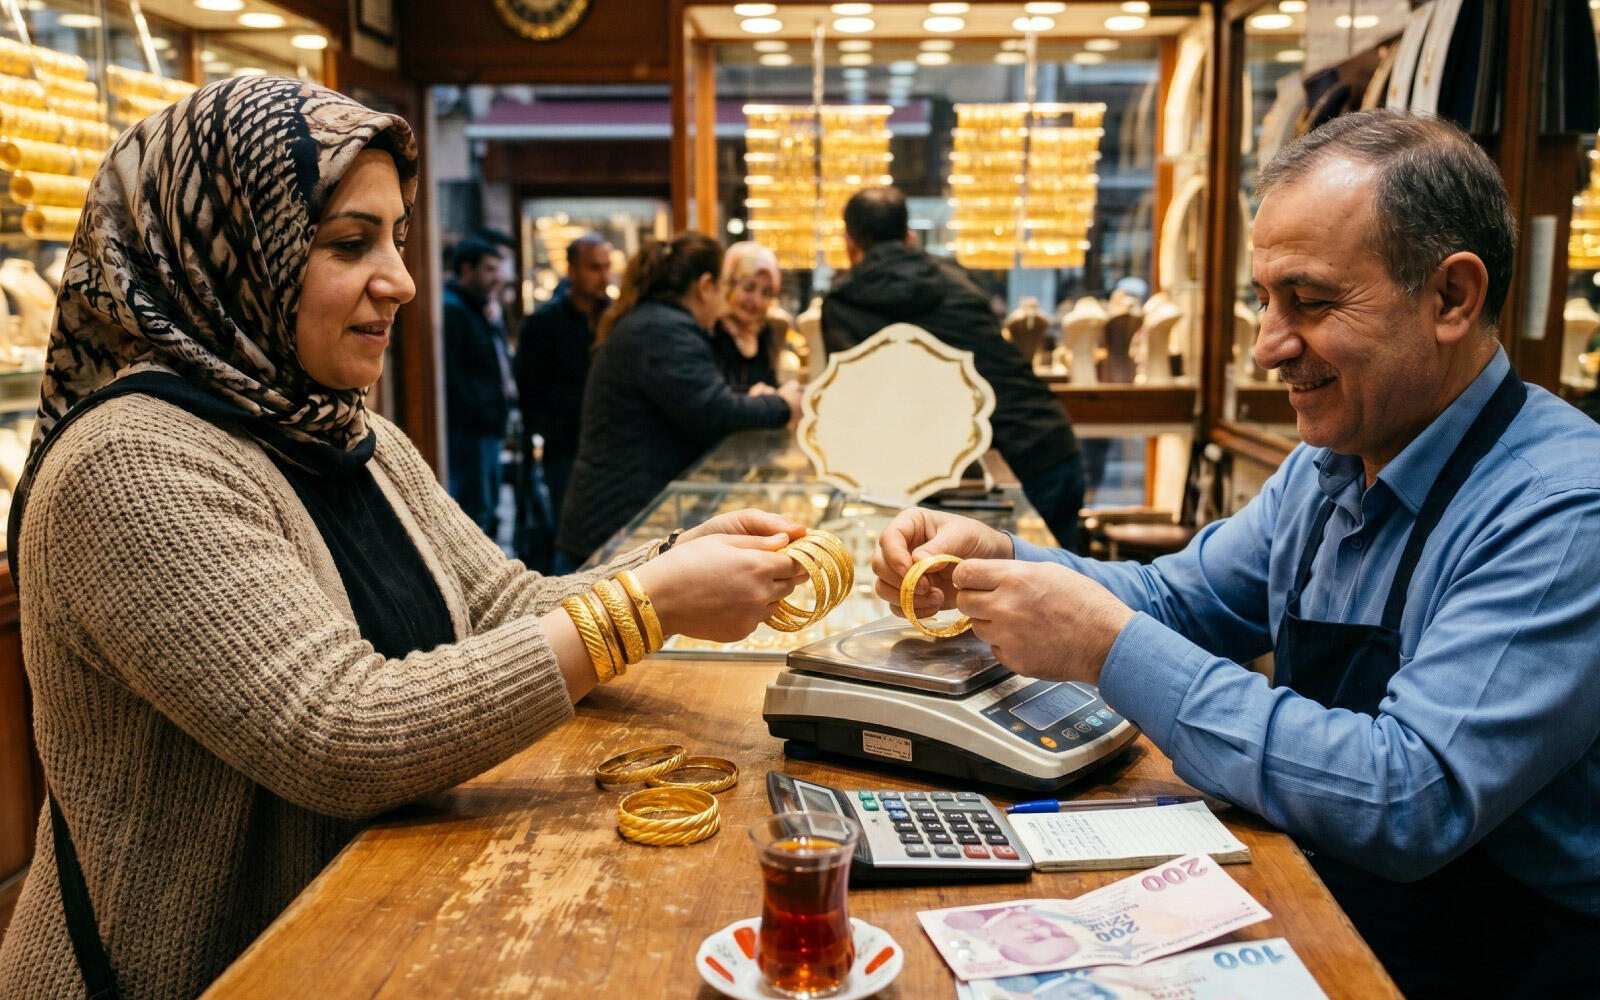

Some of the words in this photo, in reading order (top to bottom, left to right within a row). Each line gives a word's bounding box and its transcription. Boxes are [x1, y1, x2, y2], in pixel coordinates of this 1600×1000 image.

[1141, 857, 1208, 892] 200
[1095, 921, 1140, 942] 200
[1213, 945, 1286, 970] 100
